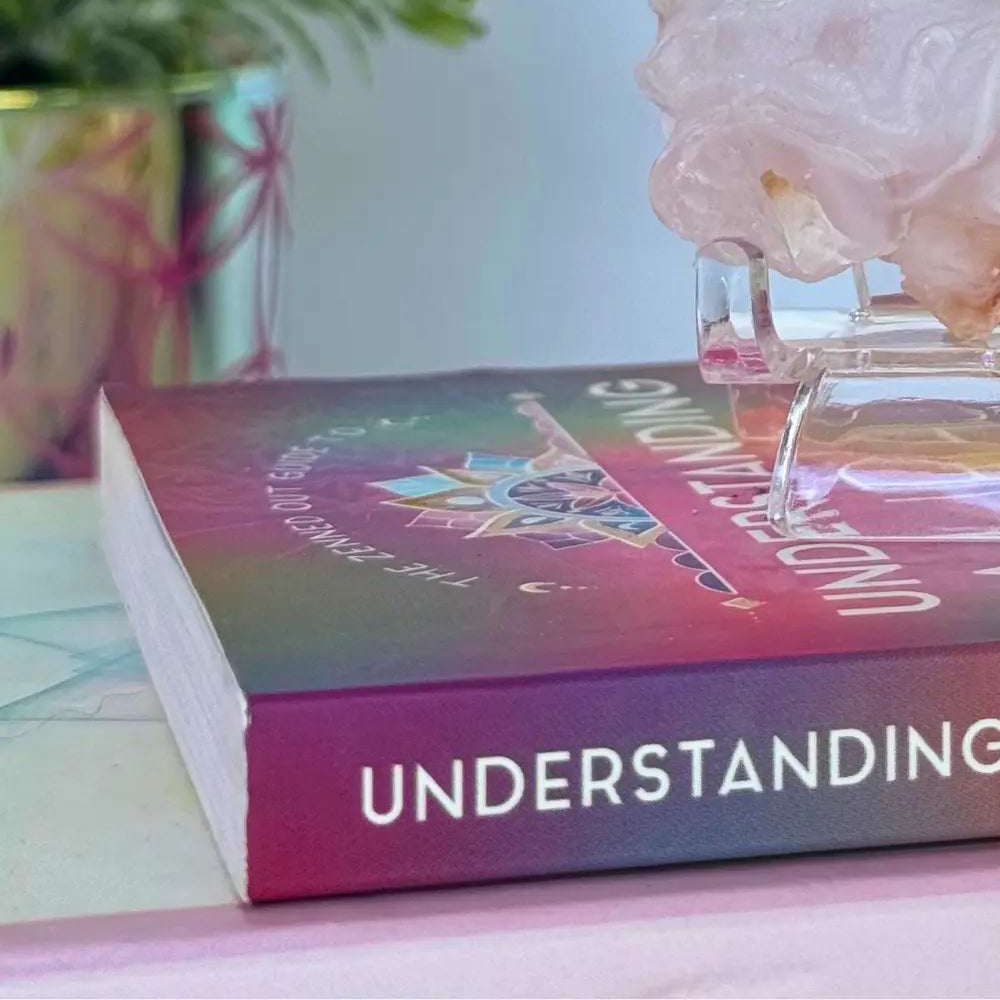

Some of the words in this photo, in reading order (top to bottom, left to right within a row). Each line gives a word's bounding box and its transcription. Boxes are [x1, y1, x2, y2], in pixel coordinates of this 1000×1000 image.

[268, 445, 330, 480] GUIDE
[266, 485, 313, 511] OUT
[284, 515, 395, 562] ZENNED
[383, 562, 479, 587] THE
